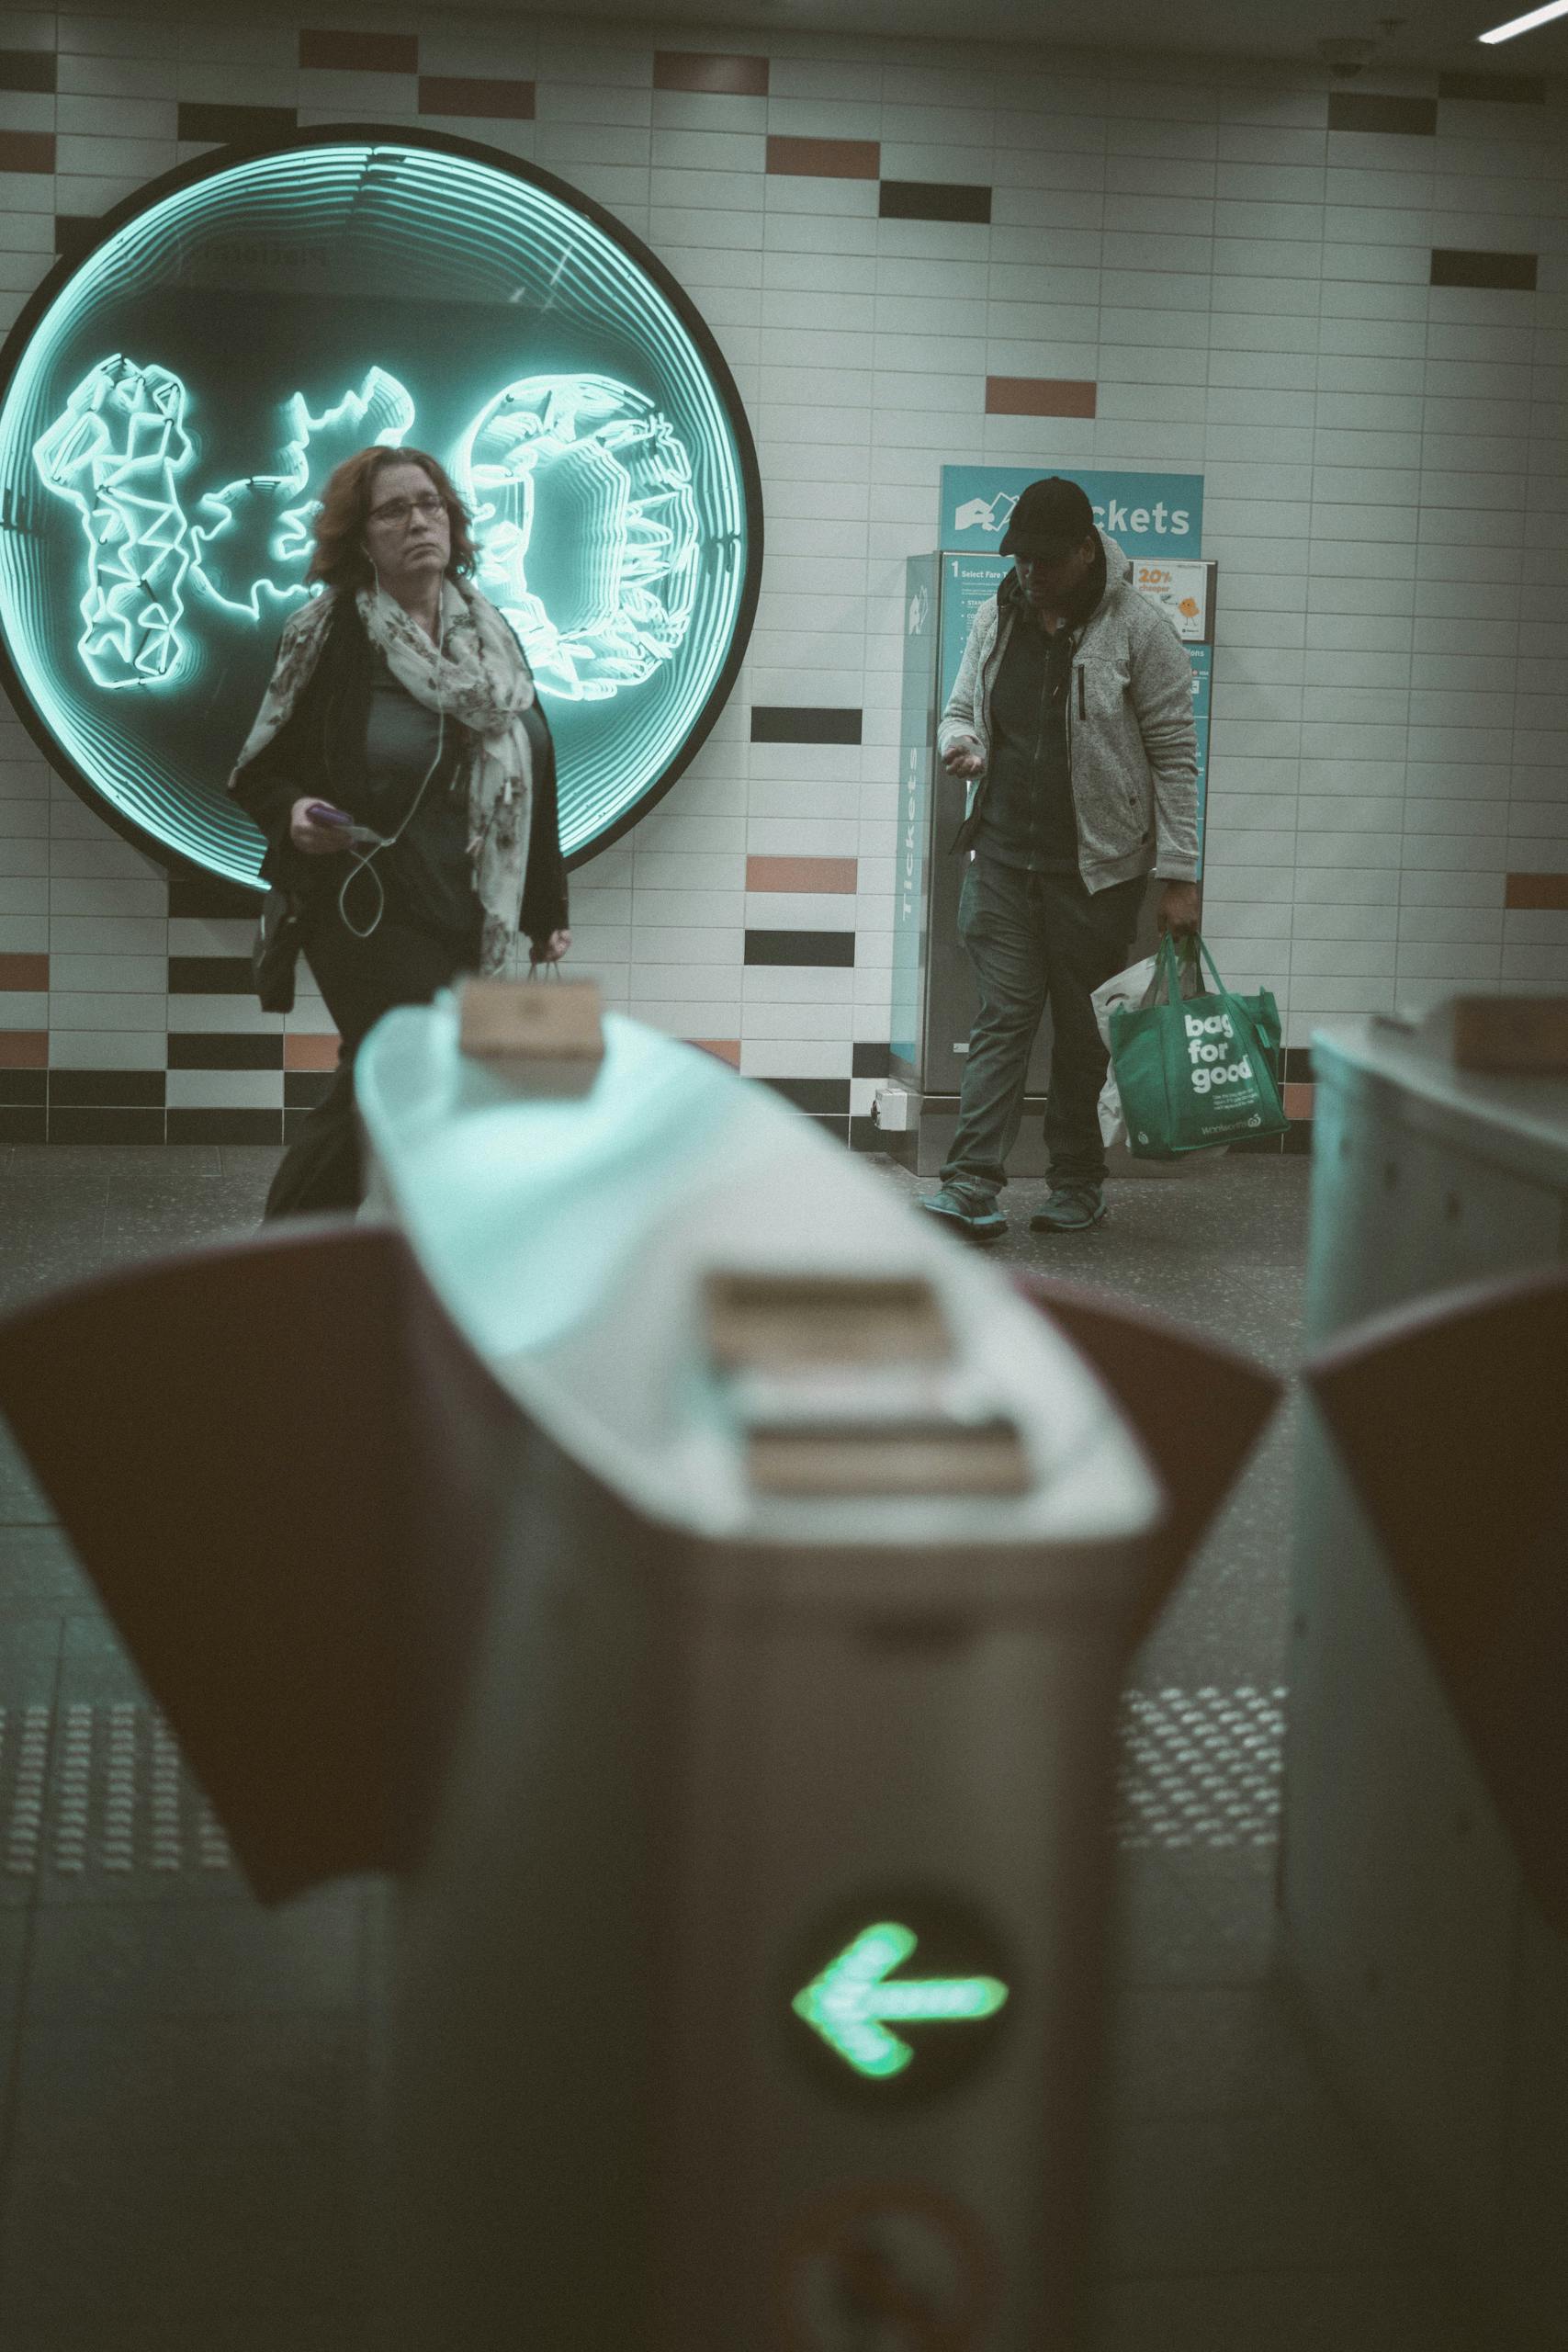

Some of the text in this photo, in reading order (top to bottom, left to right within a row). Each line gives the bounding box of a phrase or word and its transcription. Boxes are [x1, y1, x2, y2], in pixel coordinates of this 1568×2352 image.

[1091, 499, 1190, 536] ckets
[952, 560, 959, 578] 1
[1138, 569, 1172, 583] 20%
[902, 747, 918, 922] Tickets
[1184, 1013, 1234, 1038] bag
[1188, 1039, 1228, 1064] for
[1190, 1054, 1253, 1093] good
